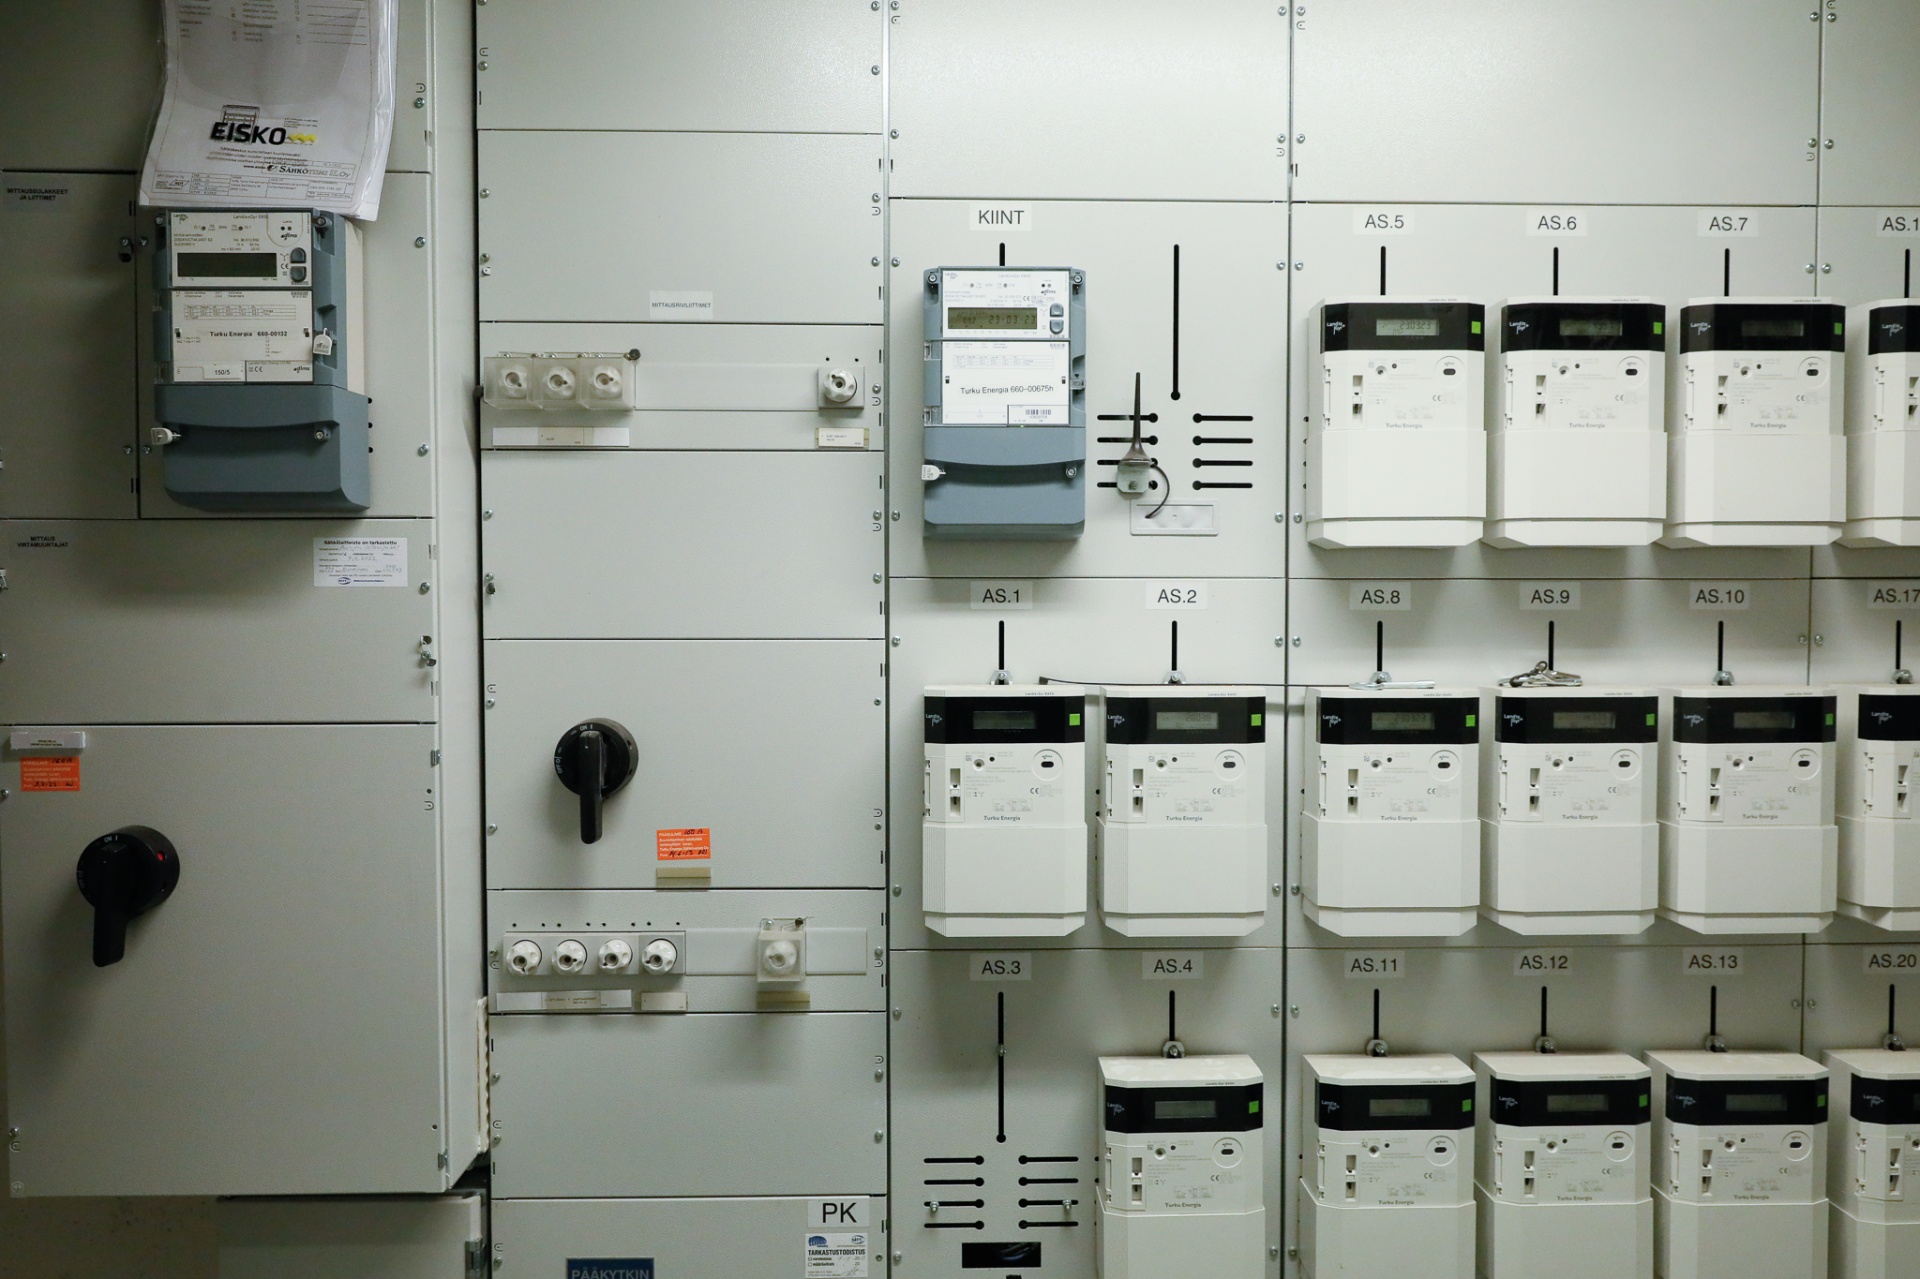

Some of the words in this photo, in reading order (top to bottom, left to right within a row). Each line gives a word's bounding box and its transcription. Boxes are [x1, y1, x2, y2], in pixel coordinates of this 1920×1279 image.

[210, 121, 287, 146] EISKO
[978, 210, 1025, 225] KIINT
[1365, 214, 1404, 229] AS.5
[1537, 215, 1577, 231] AS.6
[1709, 216, 1748, 231] AS.7
[960, 387, 981, 395] Turku
[982, 386, 1009, 395] Energia
[982, 589, 1021, 604] AS.1
[1157, 589, 1197, 604] AS.2
[1361, 589, 1401, 605] AS.8
[1531, 589, 1570, 605] AS.9
[1695, 589, 1745, 605] AS.10
[1873, 588, 1920, 603] AS.17
[982, 960, 1021, 975] AS.3
[1153, 958, 1193, 974] AS.4
[1350, 957, 1397, 973] AS.11
[1519, 955, 1568, 970] AS.12
[1688, 954, 1738, 970] AS.13
[1868, 953, 1917, 968] AS.20
[822, 1202, 857, 1223] PK
[571, 1266, 649, 1279] PÄÄKYTKIN
